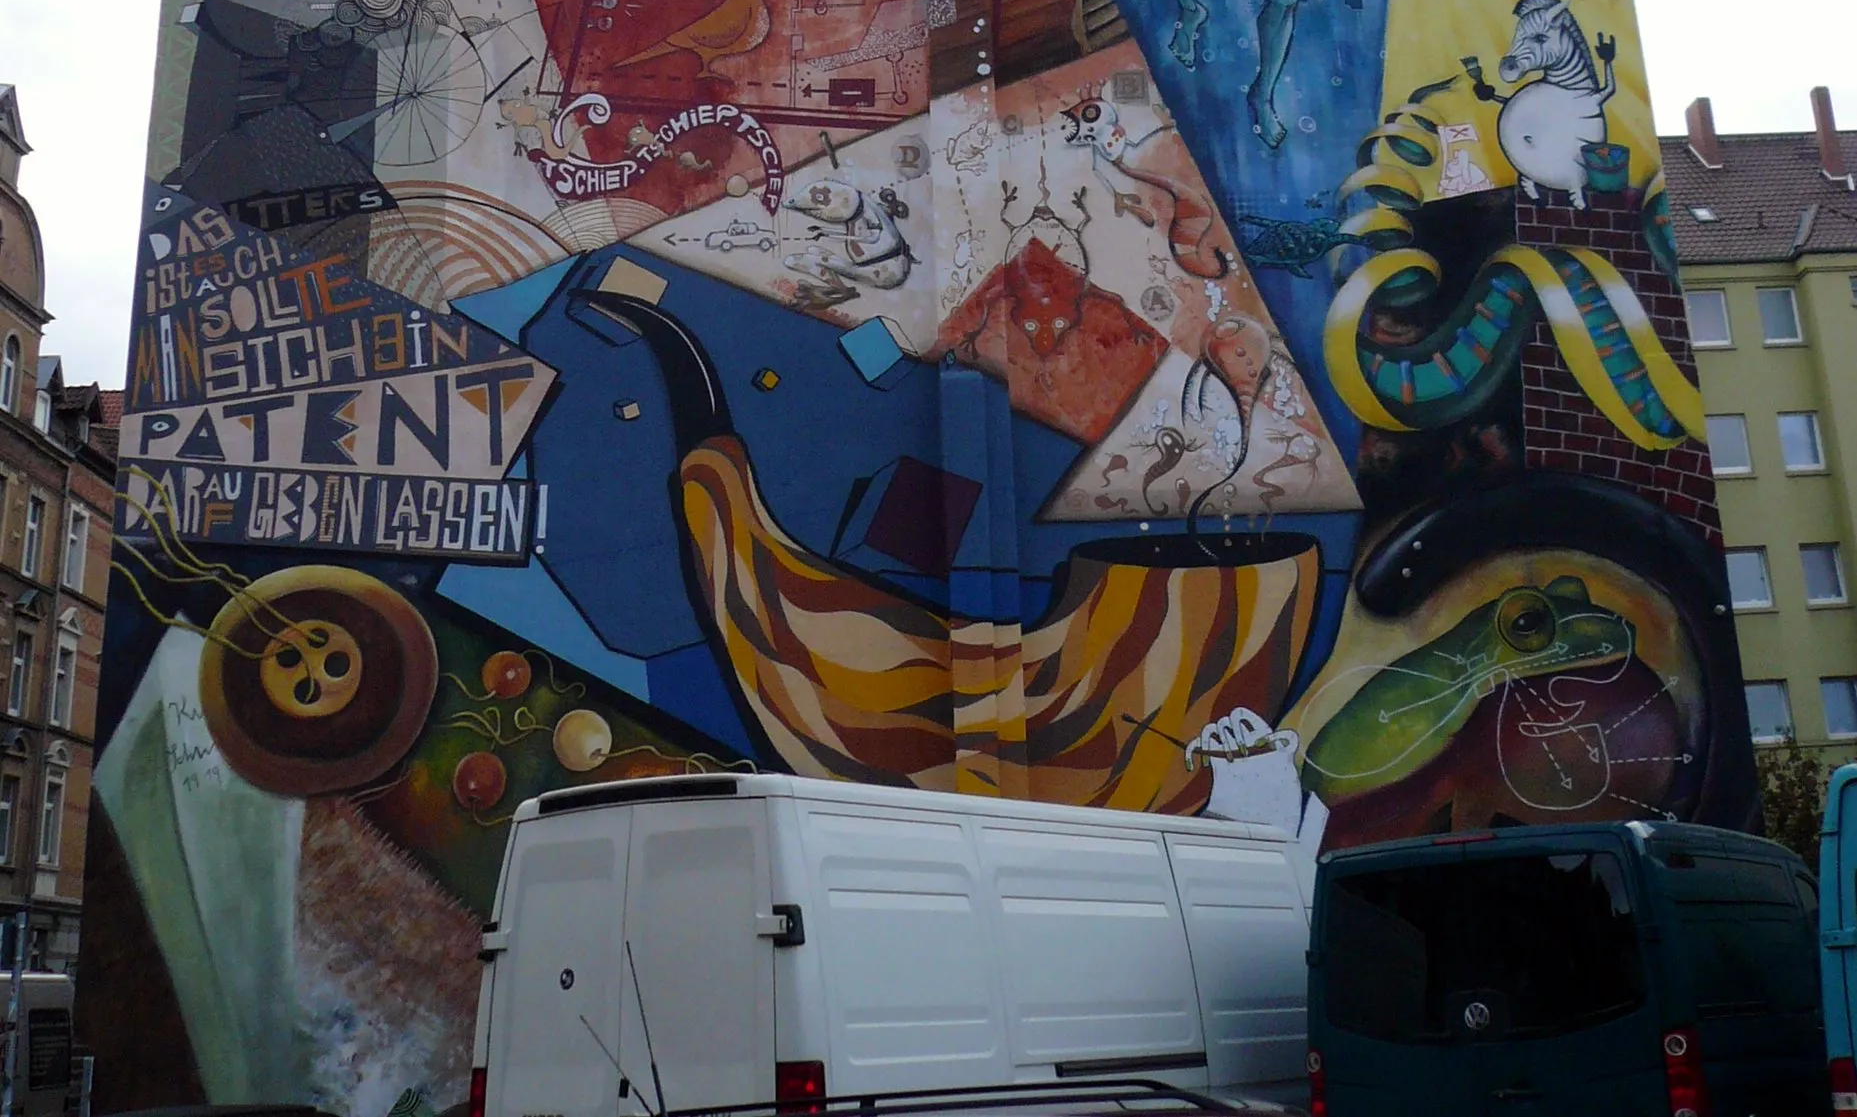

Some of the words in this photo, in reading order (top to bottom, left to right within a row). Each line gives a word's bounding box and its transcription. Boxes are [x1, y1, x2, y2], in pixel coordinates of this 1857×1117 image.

[899, 145, 920, 169] D
[149, 206, 235, 261] DAS
[193, 253, 227, 276] ES
[200, 253, 372, 342] SOLLTE
[131, 307, 201, 408] MAN
[202, 318, 367, 399] SICH
[139, 363, 535, 472] PATENT
[245, 471, 373, 546] GEBEN
